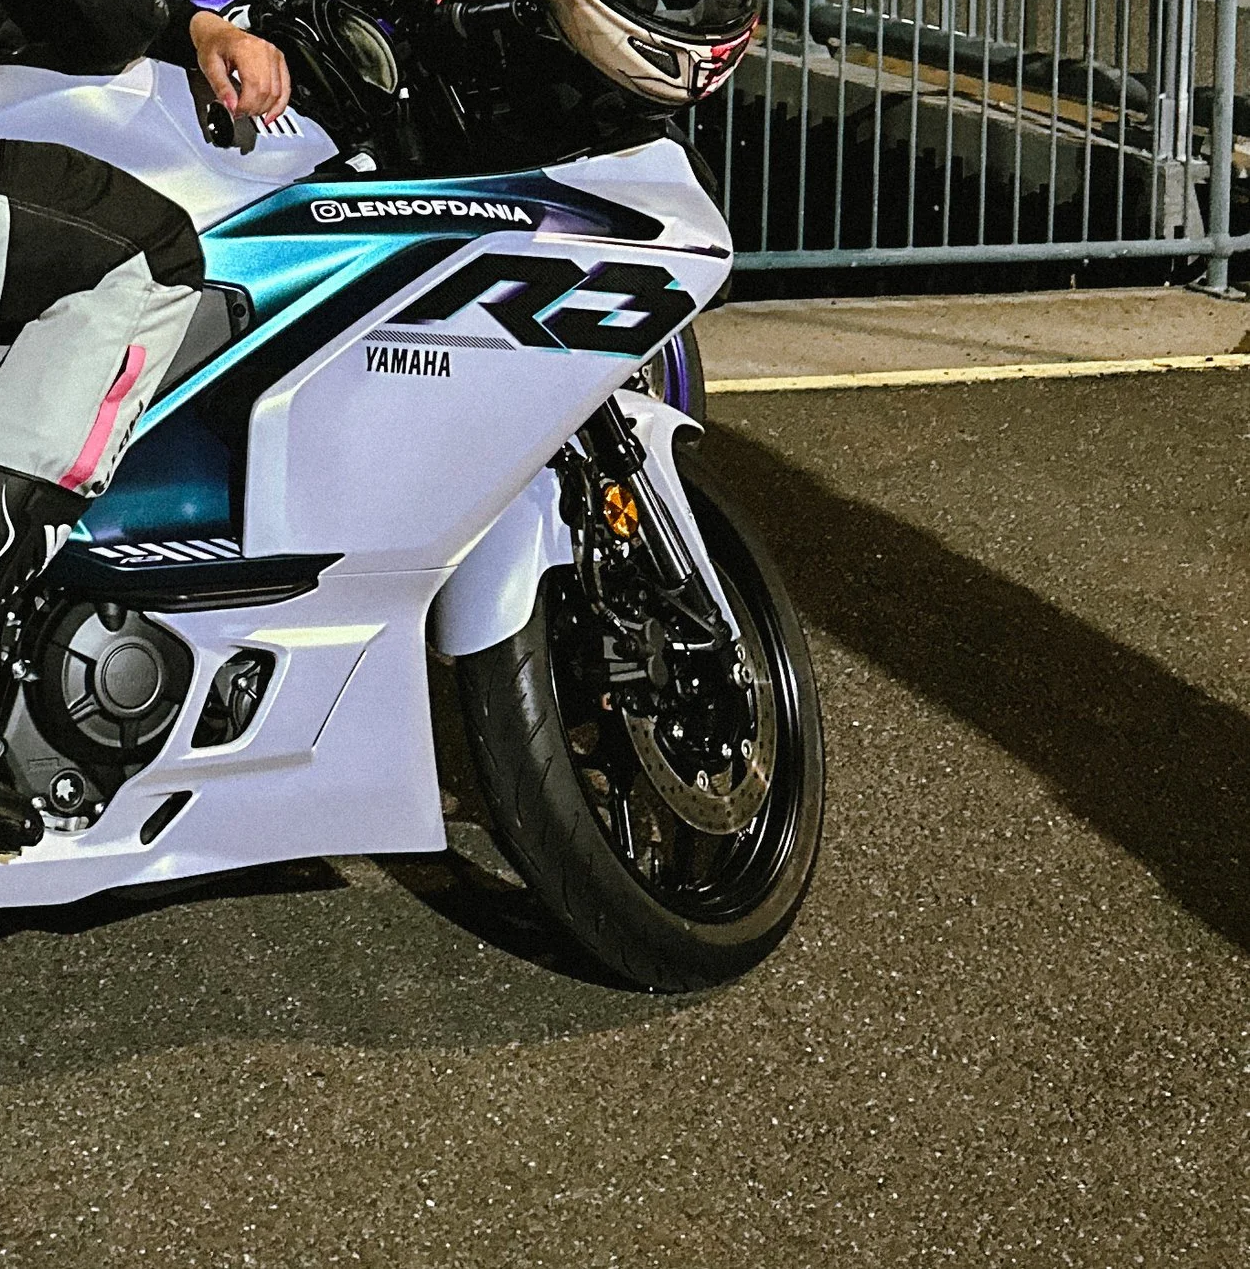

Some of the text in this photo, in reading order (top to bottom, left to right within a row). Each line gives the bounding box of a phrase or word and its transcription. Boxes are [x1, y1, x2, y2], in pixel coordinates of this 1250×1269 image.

[344, 199, 533, 225] LENSOFDANIA
[385, 252, 696, 359] R3
[366, 346, 451, 378] YAMAHA
